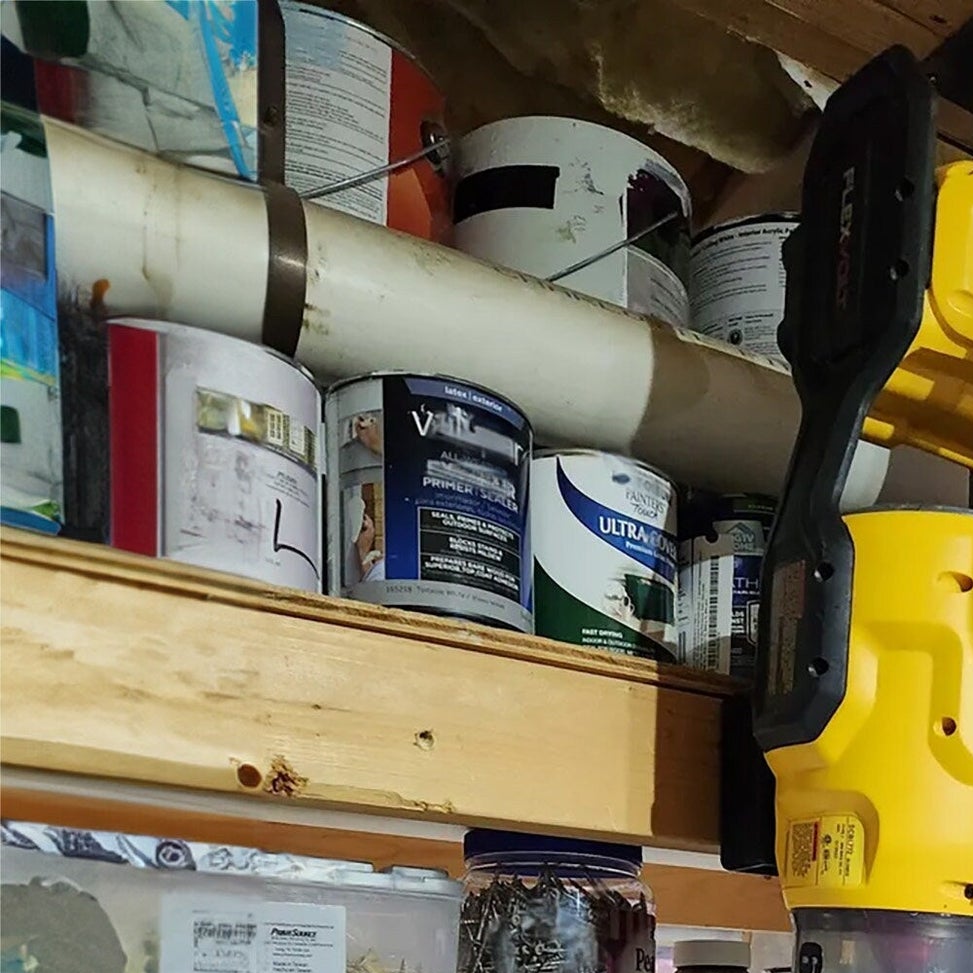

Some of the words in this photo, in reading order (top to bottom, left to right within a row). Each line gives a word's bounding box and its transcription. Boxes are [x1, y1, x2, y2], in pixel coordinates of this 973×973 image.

[444, 386, 468, 398] latex
[423, 477, 473, 494] PRIMER
[599, 516, 649, 544] ULTRA
[582, 628, 598, 636] FAST
[599, 629, 623, 639] DRYING
